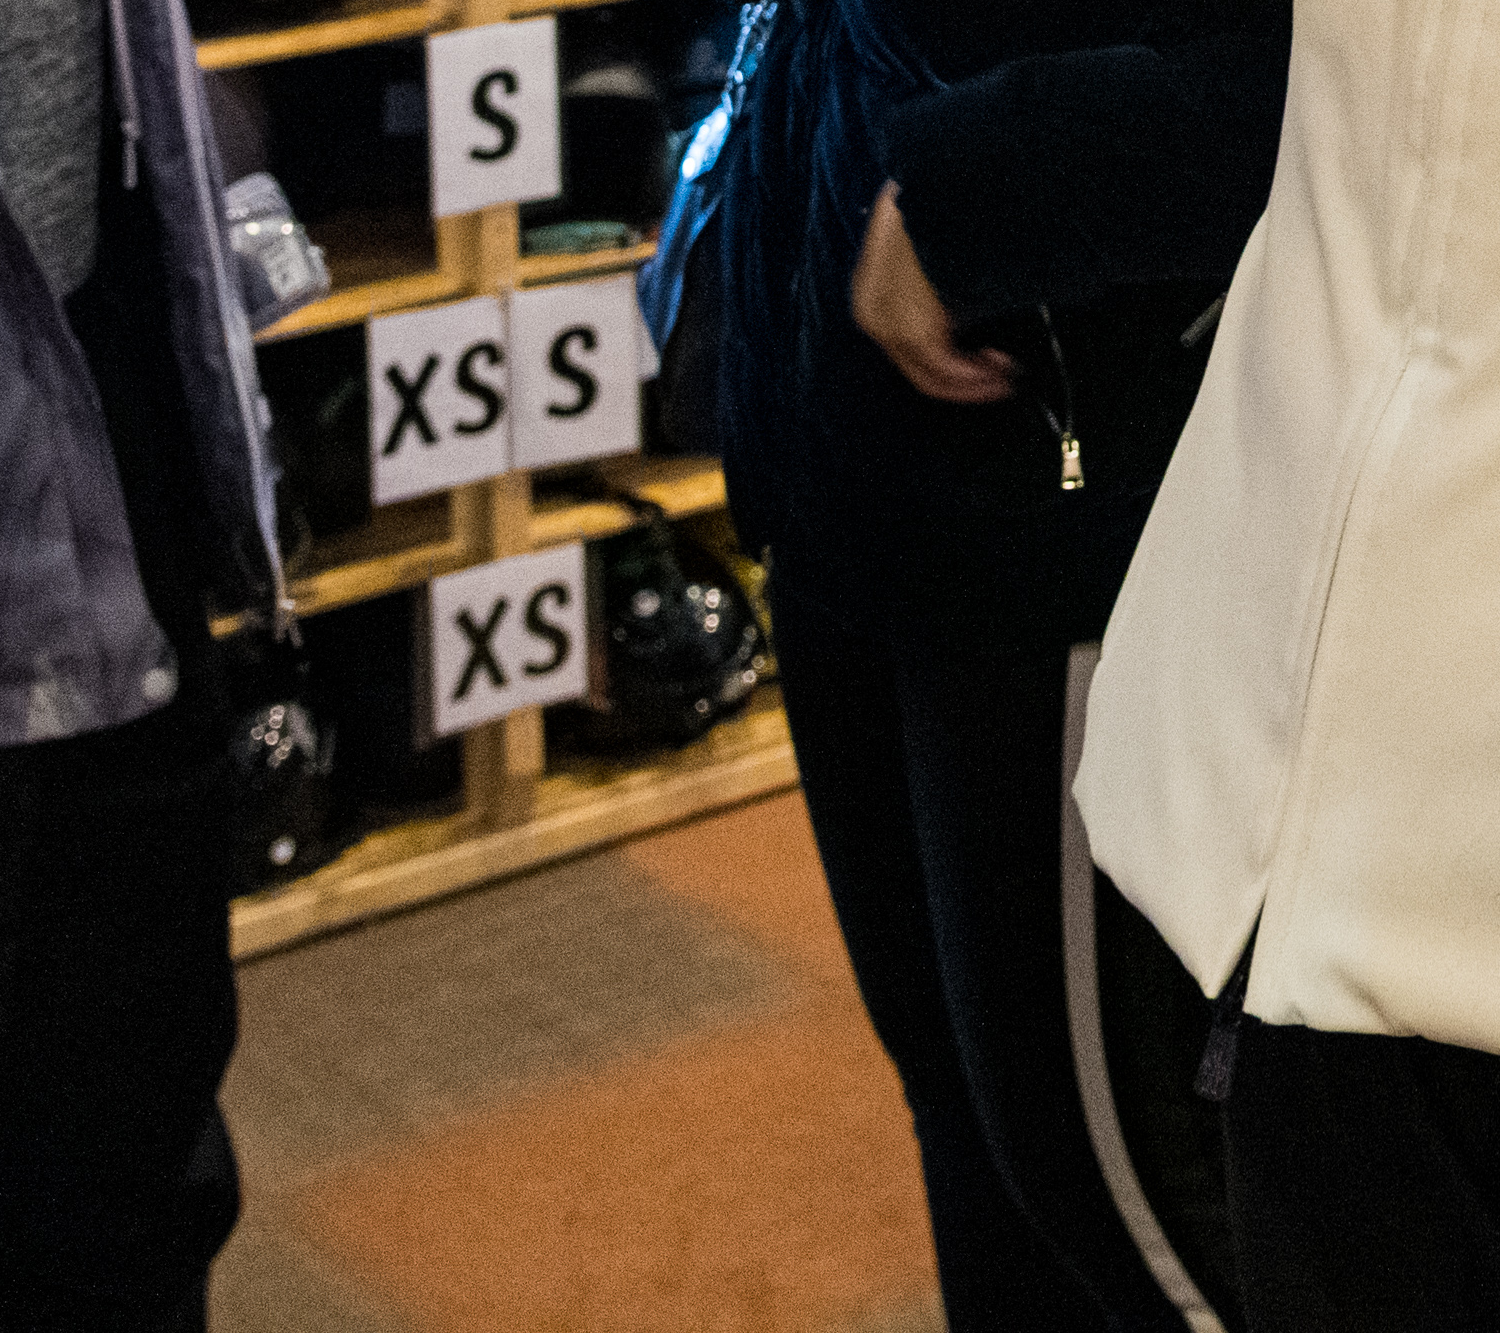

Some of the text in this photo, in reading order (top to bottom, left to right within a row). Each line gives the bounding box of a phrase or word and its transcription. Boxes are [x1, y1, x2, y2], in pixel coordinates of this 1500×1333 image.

[468, 69, 521, 164] S
[381, 341, 504, 458] XS
[546, 324, 600, 420] S
[452, 582, 570, 704] XS
